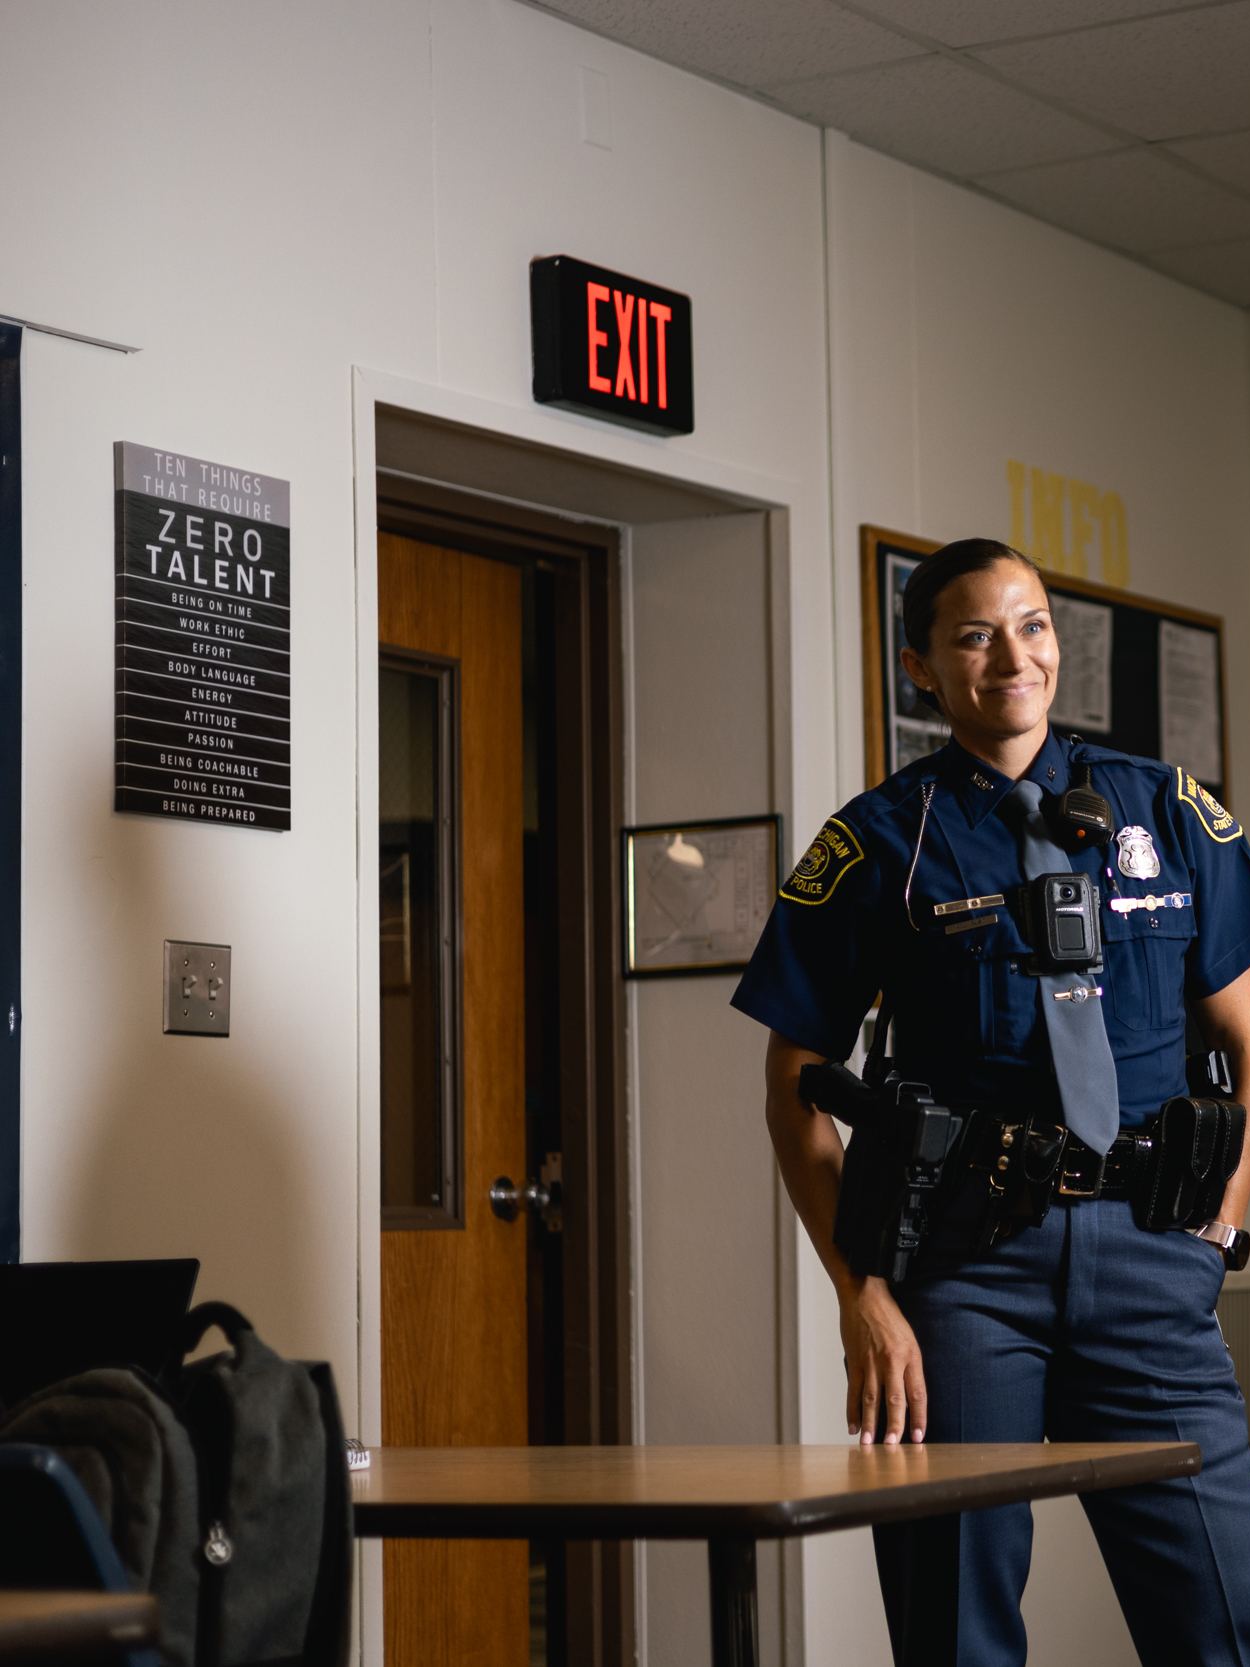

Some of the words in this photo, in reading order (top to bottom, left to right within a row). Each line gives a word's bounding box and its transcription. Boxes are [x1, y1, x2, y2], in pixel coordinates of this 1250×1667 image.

[587, 281, 672, 410] EXIT
[154, 452, 186, 478] TEN
[200, 464, 261, 496] THINGS
[143, 475, 188, 502] THAT
[198, 488, 271, 522] REQUIRE
[158, 508, 262, 562] ZERO
[1006, 459, 1131, 589] INFO
[145, 544, 275, 599] TALENT
[171, 592, 203, 609] BEING
[208, 600, 223, 612] ON
[228, 604, 252, 618] TIME
[179, 617, 210, 633] WORK
[215, 624, 245, 640] ETHIC
[192, 642, 232, 659] EFFORT
[168, 661, 197, 676] BODY
[201, 666, 256, 686] LANGUAGE
[191, 687, 233, 704] ENERGY
[184, 710, 237, 729] ATTITUDE
[188, 733, 234, 750] PASSION
[160, 753, 193, 768] BEING
[198, 759, 259, 778] COACHABLE
[173, 778, 207, 793] DOING
[212, 784, 245, 799] EXTRA
[162, 800, 196, 815] BEING
[201, 806, 256, 822] PREPARED
[818, 827, 850, 859] CHIGAN
[790, 876, 822, 894] POLICE
